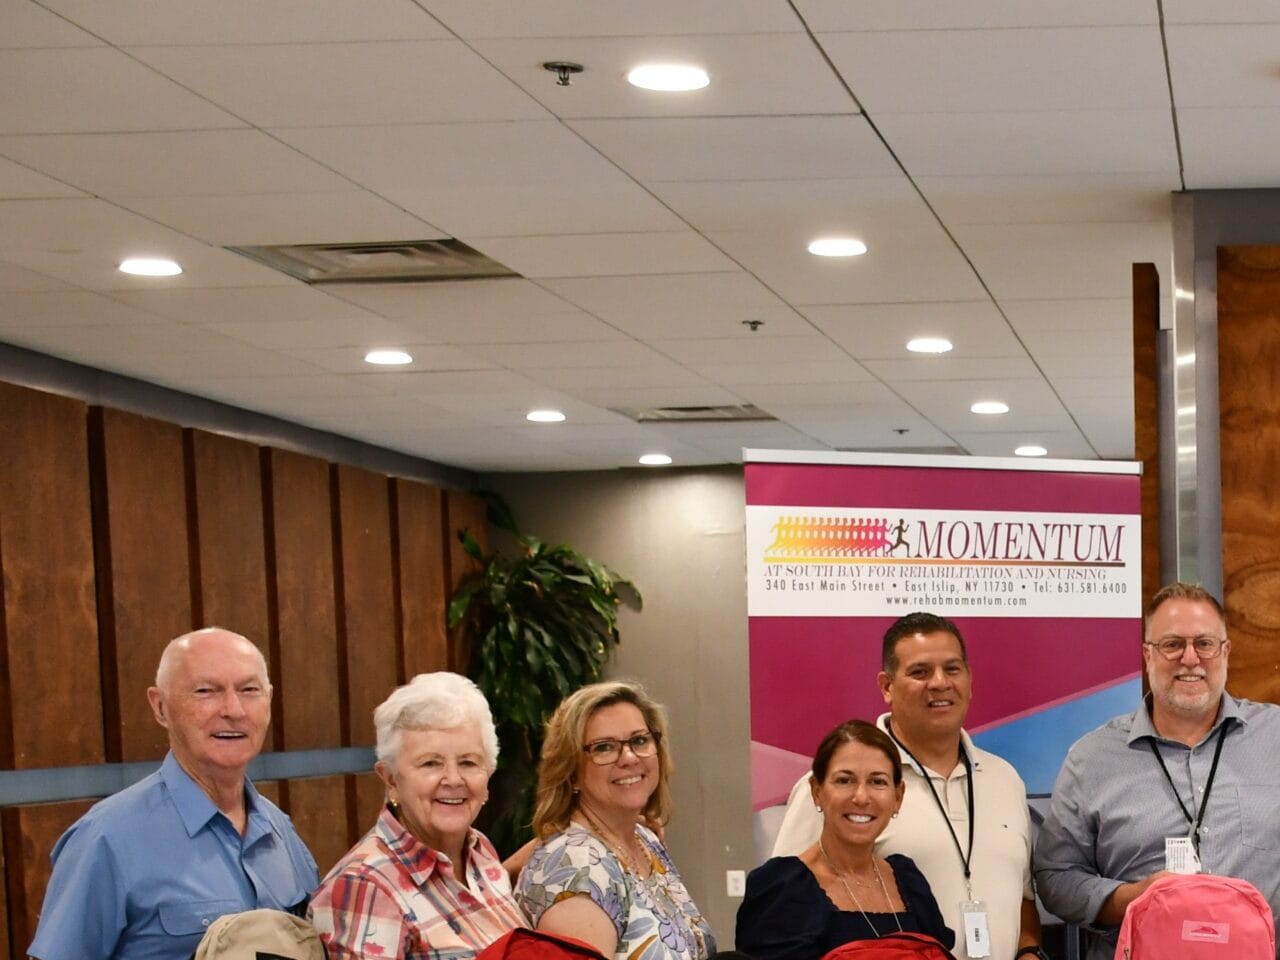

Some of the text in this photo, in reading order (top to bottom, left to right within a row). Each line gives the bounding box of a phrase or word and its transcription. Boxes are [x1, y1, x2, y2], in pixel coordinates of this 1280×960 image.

[914, 520, 1126, 562] MOMENTUM
[764, 565, 1106, 581] AT SOUTH BAY FOR REHABILITATION AND NURSING
[766, 579, 1127, 594] 340 East Main Street East Islip, NY 11730 Tel: 631.581.6400
[886, 594, 1027, 606] www.rehabmomentum.com
